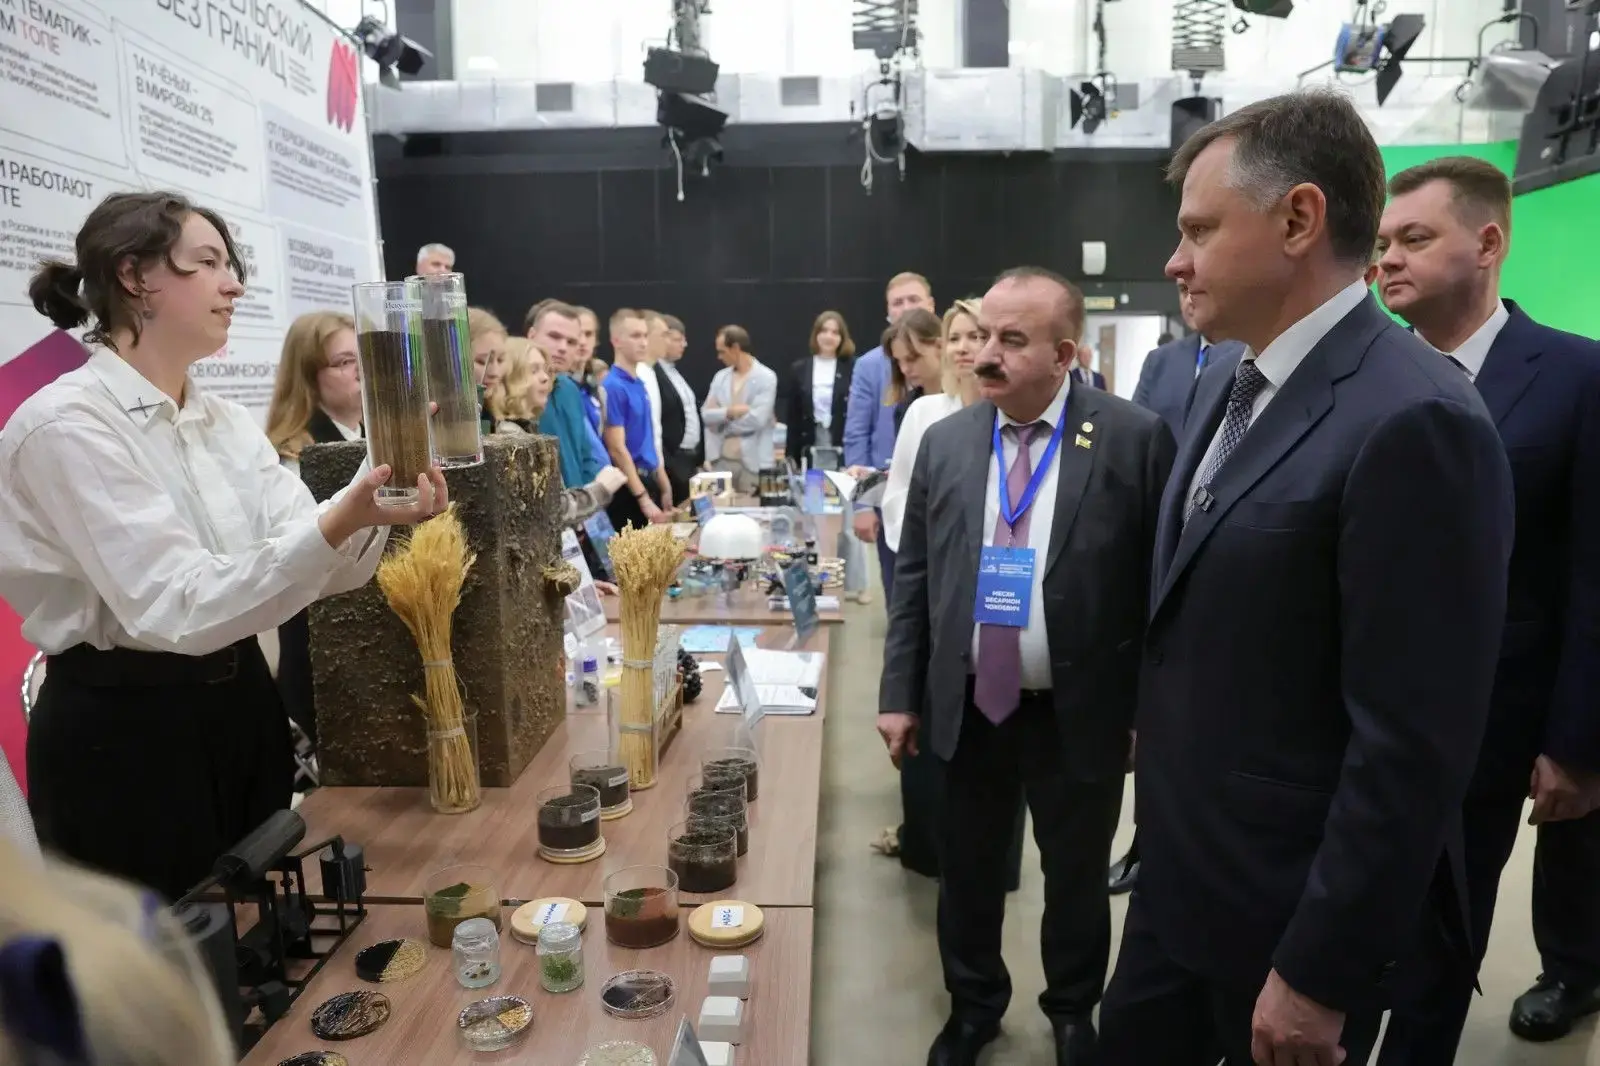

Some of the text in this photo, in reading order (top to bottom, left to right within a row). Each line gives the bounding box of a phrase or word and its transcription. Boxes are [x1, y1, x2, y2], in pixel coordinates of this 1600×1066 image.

[18, 18, 61, 57] ТОПЕ
[206, 1, 288, 88] ГРАНИЦ
[230, 0, 314, 60] ЛЬСКИЙ
[9, 160, 94, 200] РАБОТАЮТ
